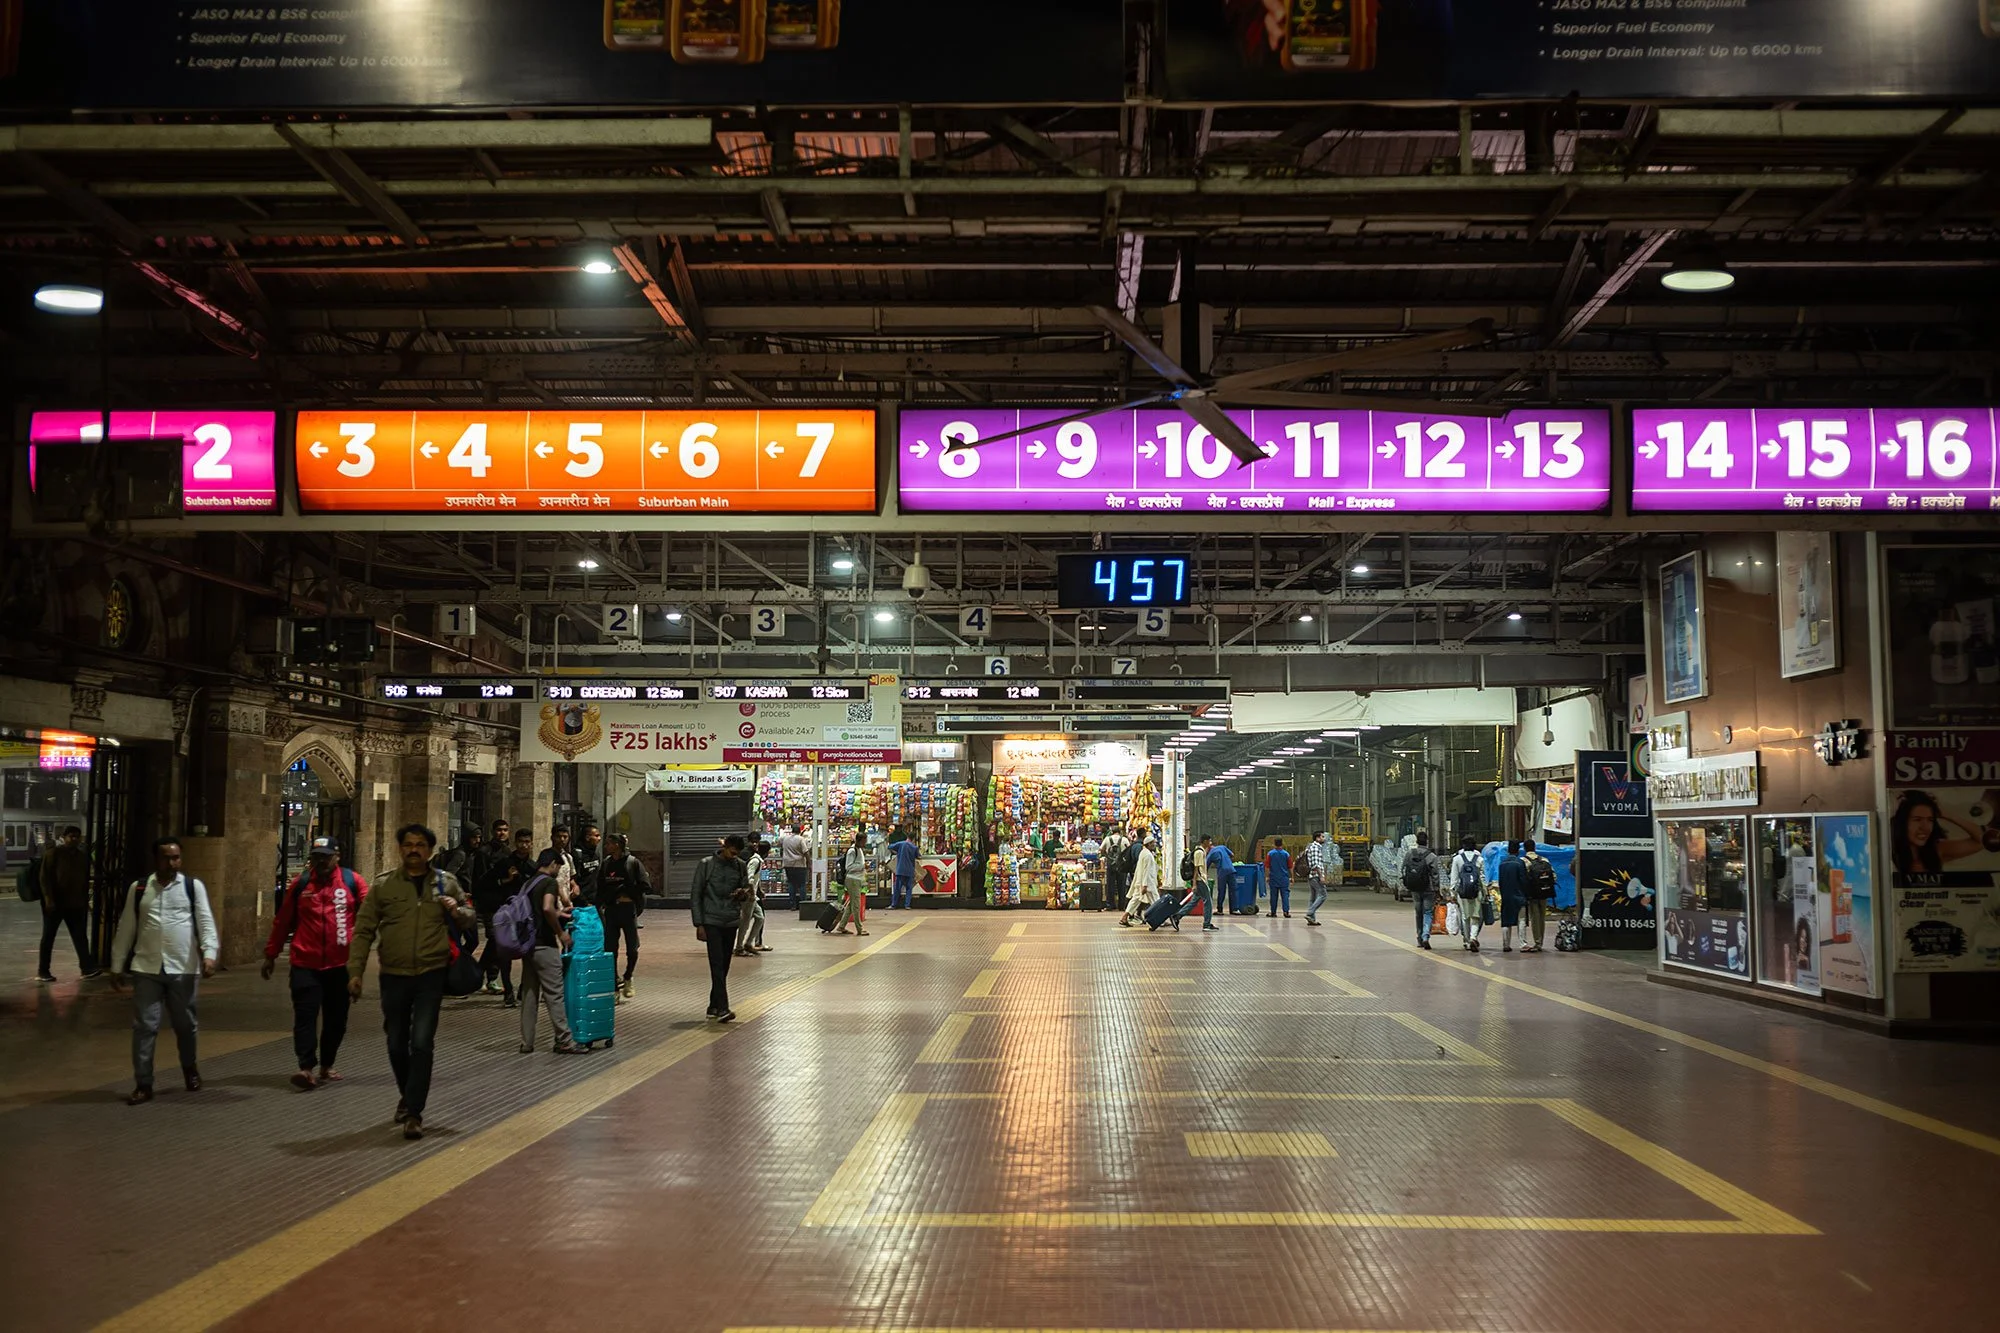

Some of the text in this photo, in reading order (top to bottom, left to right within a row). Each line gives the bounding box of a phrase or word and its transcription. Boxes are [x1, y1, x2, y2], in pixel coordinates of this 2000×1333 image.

[1676, 0, 1747, 10] compliant
[190, 9, 229, 20] JASO
[1552, 21, 1715, 36] Superior Fuel Economy
[190, 32, 347, 47] Superior Fuel Economy
[1553, 43, 1824, 61] Longer Drain Interval: Up to 6000 kms
[187, 55, 237, 69] Longer
[240, 55, 276, 68] Drain
[280, 55, 335, 68] Interval:
[339, 55, 360, 69] Up
[362, 56, 377, 67] to
[192, 423, 233, 479] 2
[337, 423, 376, 477] 3
[447, 423, 492, 477] 4
[564, 422, 604, 478] 5
[678, 422, 720, 478] 6
[795, 422, 835, 477] 7
[938, 421, 981, 478] 8
[1055, 421, 1098, 478] 9
[1156, 421, 1233, 478] 10
[1284, 421, 1341, 478] 11
[1394, 421, 1467, 478] 12
[1513, 421, 1585, 478] 13
[1656, 421, 1734, 478] 14
[1778, 421, 1852, 478] 15
[1898, 421, 1973, 478] 16
[185, 495, 272, 507] Suburban Harbour
[445, 493, 516, 508] उपनगरीय मेन
[538, 493, 610, 508] उपनगरीय मेन
[638, 495, 729, 508] Suburban Main
[1105, 493, 1126, 508] मेल
[1207, 493, 1228, 508] मेल
[1308, 496, 1395, 511] Mail Express
[1784, 493, 1804, 508] मेल
[1887, 492, 1909, 507] मेल
[448, 609, 460, 630] 1
[609, 608, 628, 631] 2
[757, 608, 775, 632] 3
[965, 609, 985, 631] 4
[1145, 609, 1164, 632] 5
[990, 658, 1006, 675] 6
[1117, 660, 1132, 675] 7
[880, 676, 896, 684] pnb
[481, 685, 494, 697] 12
[646, 686, 659, 698] 12
[745, 686, 788, 698] KASARA
[811, 687, 824, 698] 12
[1006, 687, 1019, 698] 12
[1067, 688, 1074, 698] 5
[760, 710, 791, 718] process
[938, 722, 944, 731] 6
[1065, 721, 1071, 730] 7
[610, 731, 649, 750] ₹25
[1894, 731, 1970, 752] Family
[823, 751, 844, 759] punjab
[1894, 755, 2000, 783] Salon
[688, 775, 715, 783] Bindal
[726, 775, 747, 783] Sons
[1603, 803, 1640, 812] VYOMA
[333, 888, 348, 946] zomato
[1624, 918, 1656, 929] 18645
